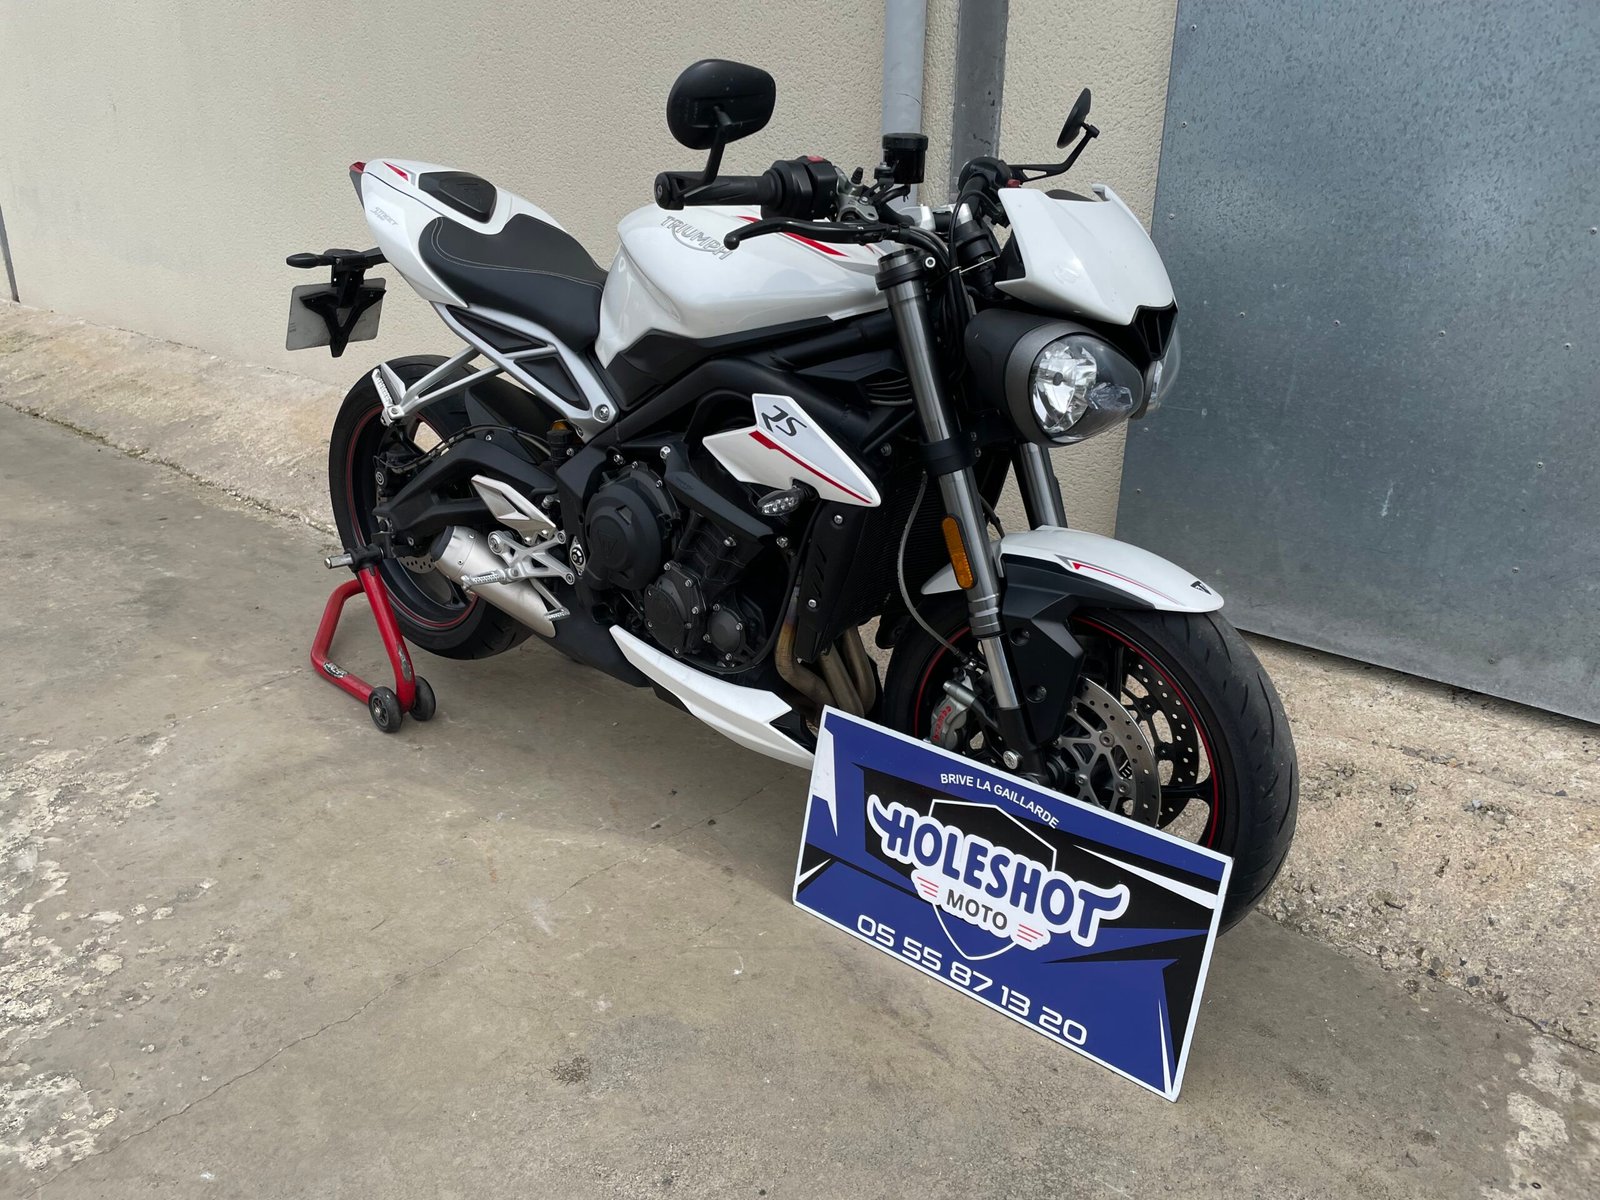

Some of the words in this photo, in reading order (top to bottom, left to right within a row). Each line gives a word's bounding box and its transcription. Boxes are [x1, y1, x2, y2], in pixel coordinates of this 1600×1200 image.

[660, 215, 734, 260] TRIUMPH
[940, 773, 974, 787] BRIVE
[976, 778, 991, 792] LA
[993, 784, 1060, 829] GAILLARDE
[870, 798, 1125, 941] HOLESHOT
[946, 888, 1008, 931] MOTO
[857, 914, 896, 947] 05
[902, 936, 943, 971] 55
[950, 961, 993, 992] 87
[1001, 985, 1031, 1017] 13
[1038, 1006, 1088, 1046] 20
